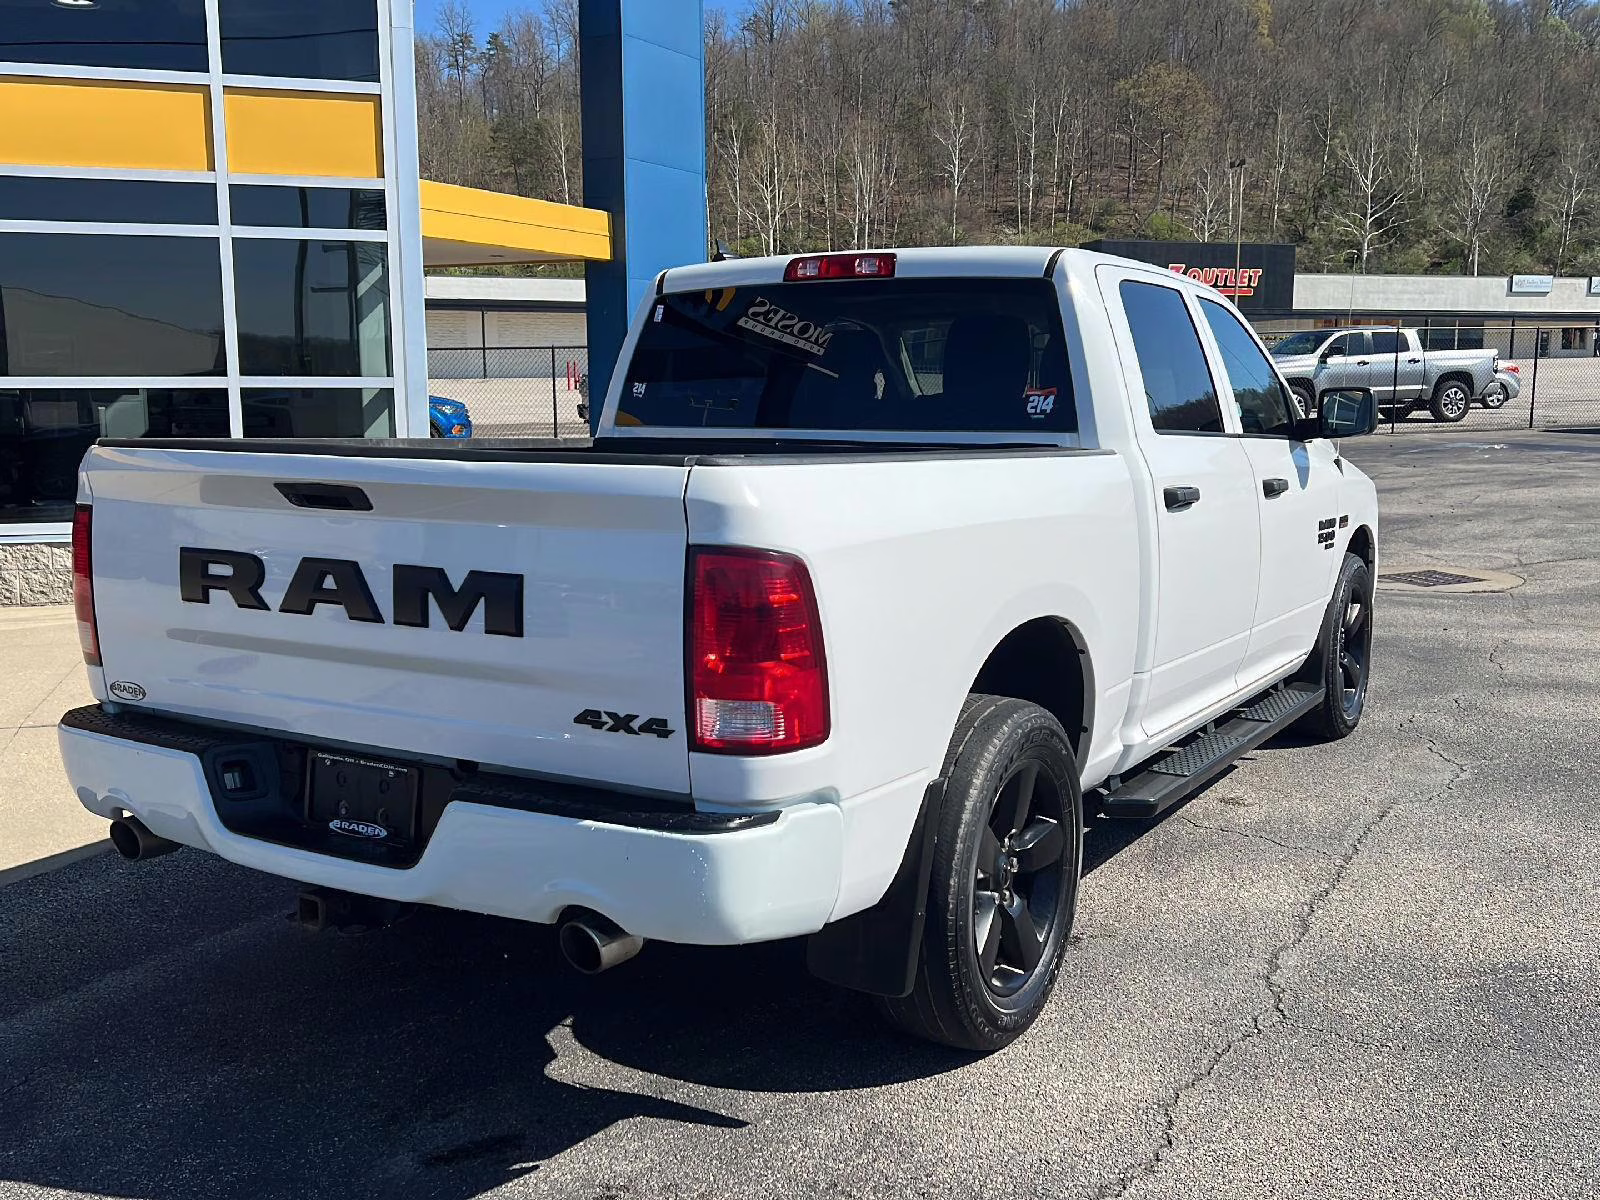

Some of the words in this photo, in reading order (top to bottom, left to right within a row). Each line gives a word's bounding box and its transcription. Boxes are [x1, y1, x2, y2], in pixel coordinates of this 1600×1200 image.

[1187, 268, 1262, 287] OUTLET
[1027, 394, 1055, 413] 214
[179, 546, 524, 638] RAM
[111, 682, 146, 697] BRADEN
[573, 708, 676, 739] 4X4
[331, 819, 384, 836] BRADEN
